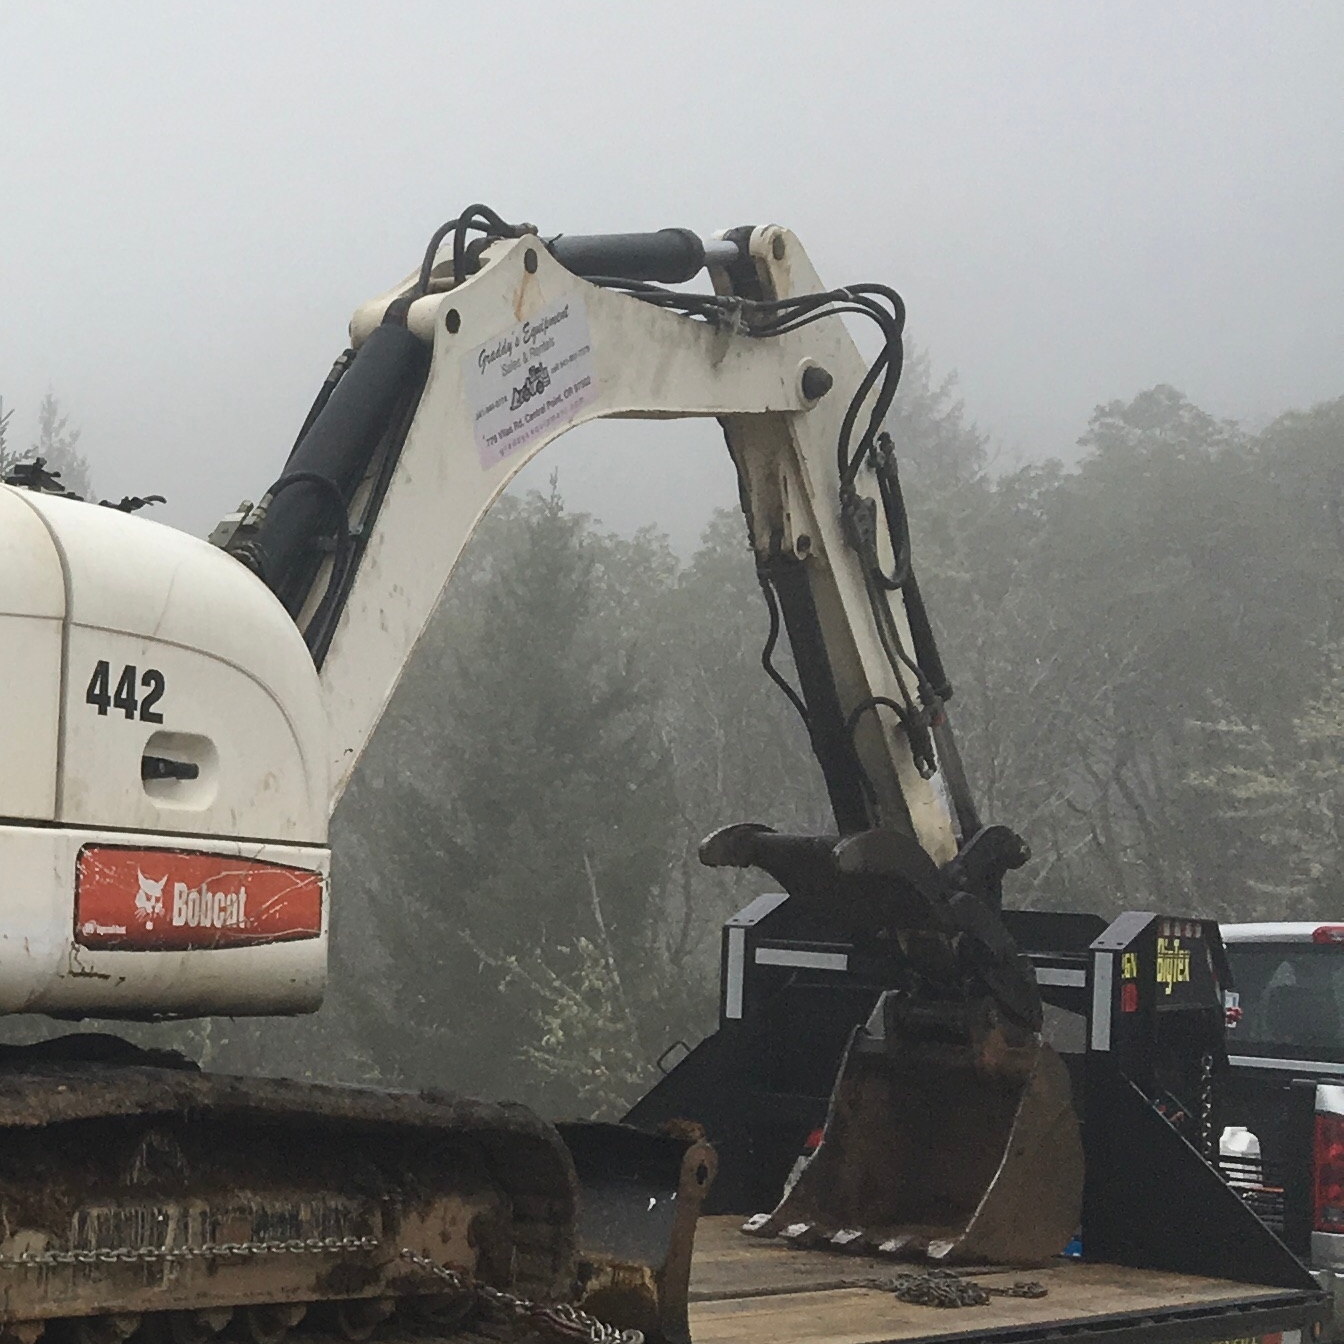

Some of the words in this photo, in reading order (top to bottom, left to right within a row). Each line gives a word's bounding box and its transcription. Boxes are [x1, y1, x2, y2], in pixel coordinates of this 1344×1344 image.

[523, 304, 569, 345] Equipment
[86, 660, 165, 724] 442
[172, 882, 248, 928] Bobcat
